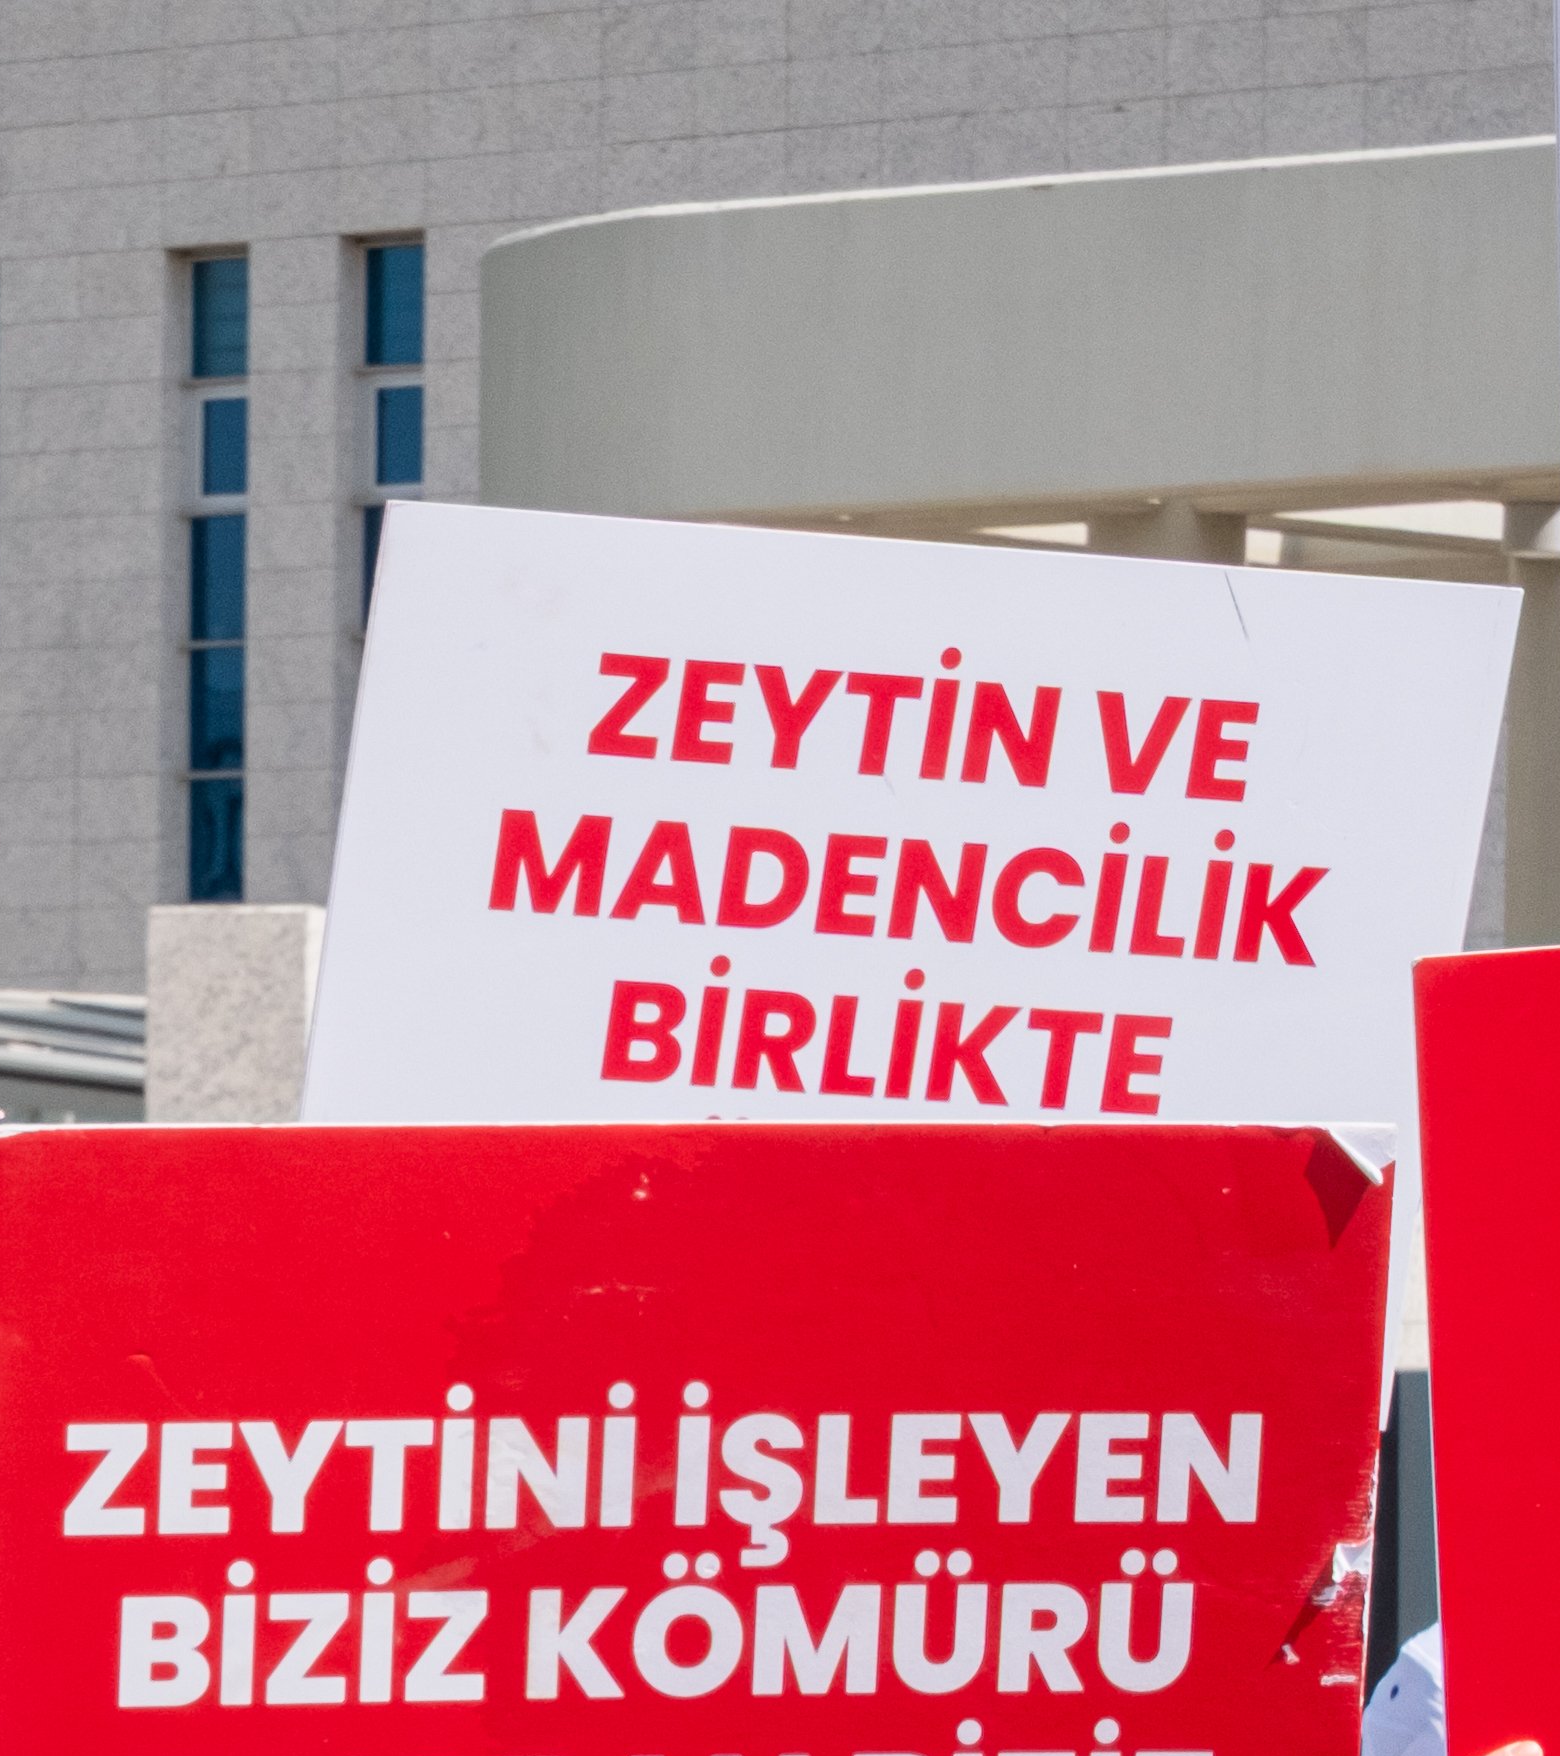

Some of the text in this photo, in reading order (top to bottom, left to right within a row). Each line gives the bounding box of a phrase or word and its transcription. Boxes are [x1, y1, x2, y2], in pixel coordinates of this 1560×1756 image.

[587, 647, 1260, 803] ZEYTİN VE
[488, 808, 1329, 967] MADENCİLİK
[600, 955, 1173, 1116] BİRLİKTE
[63, 1381, 1262, 1567] ZEYTİNİ İŞLEYEN
[118, 1549, 1194, 1708] BİZİZ KÖMÜRÜ
